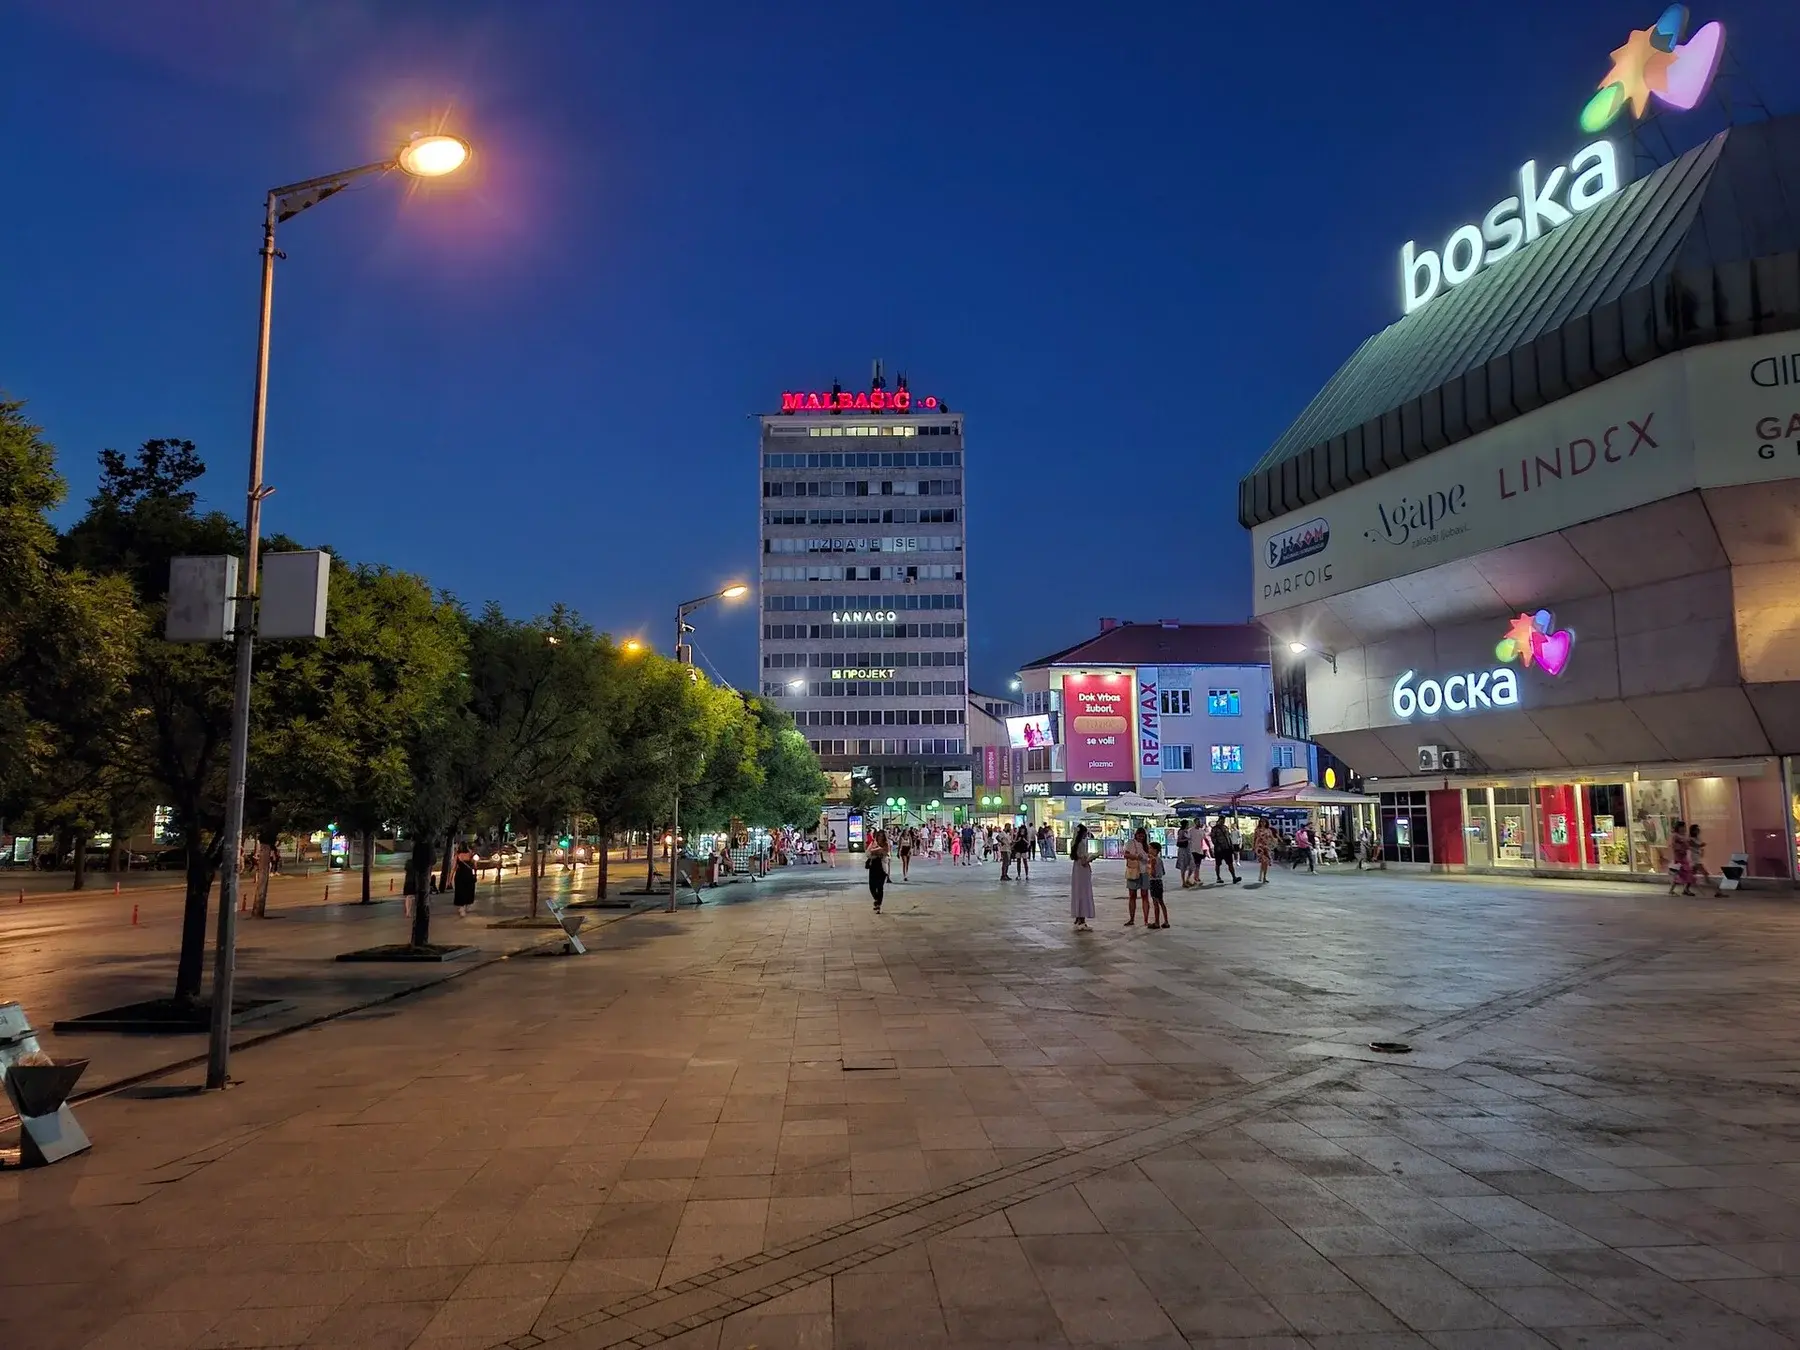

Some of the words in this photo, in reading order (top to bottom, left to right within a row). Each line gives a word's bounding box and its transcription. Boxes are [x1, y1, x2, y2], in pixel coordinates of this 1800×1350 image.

[1402, 139, 1618, 315] boska
[782, 387, 910, 410] MALBAŠIĆ
[1498, 412, 1660, 500] LINDEX
[811, 538, 879, 549] IZDAJE
[895, 537, 916, 549] SE
[1263, 563, 1333, 600] PARFOIS
[832, 611, 897, 622] LANACO
[1393, 667, 1519, 718] боска
[1140, 682, 1160, 766] RE/MAX
[1023, 783, 1049, 793] OFFICE
[1073, 782, 1109, 793] OFFICE
